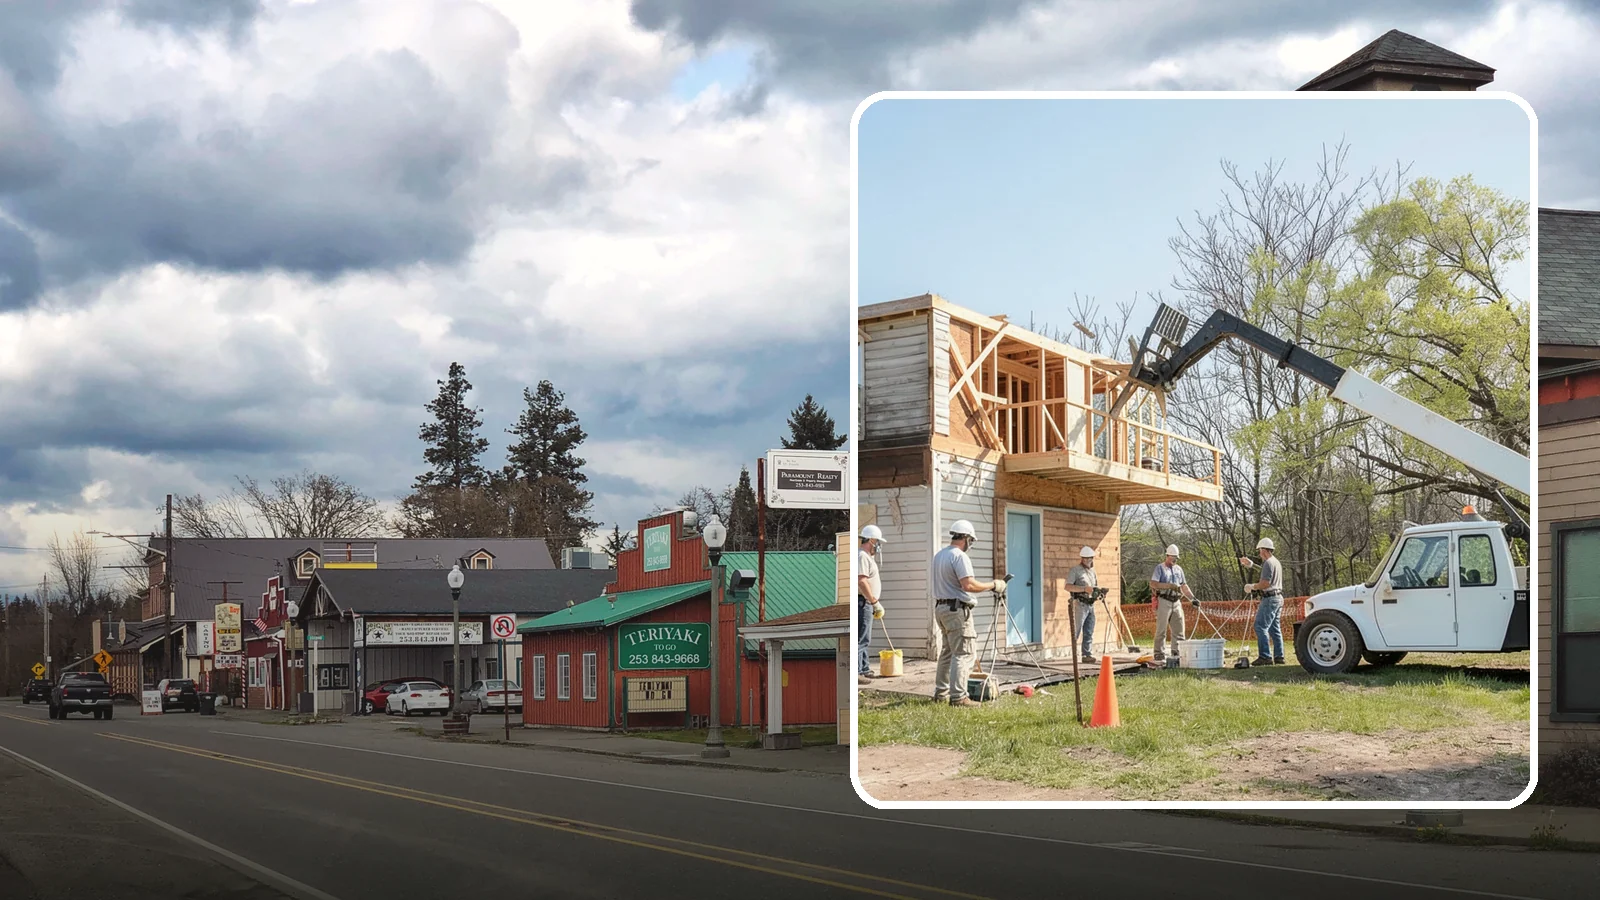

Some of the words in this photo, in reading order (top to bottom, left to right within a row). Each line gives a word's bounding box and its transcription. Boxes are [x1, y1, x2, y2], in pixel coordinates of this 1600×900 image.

[625, 627, 702, 646] TERIYAKI
[629, 655, 648, 664] 253
[651, 654, 700, 664] 843-9668
